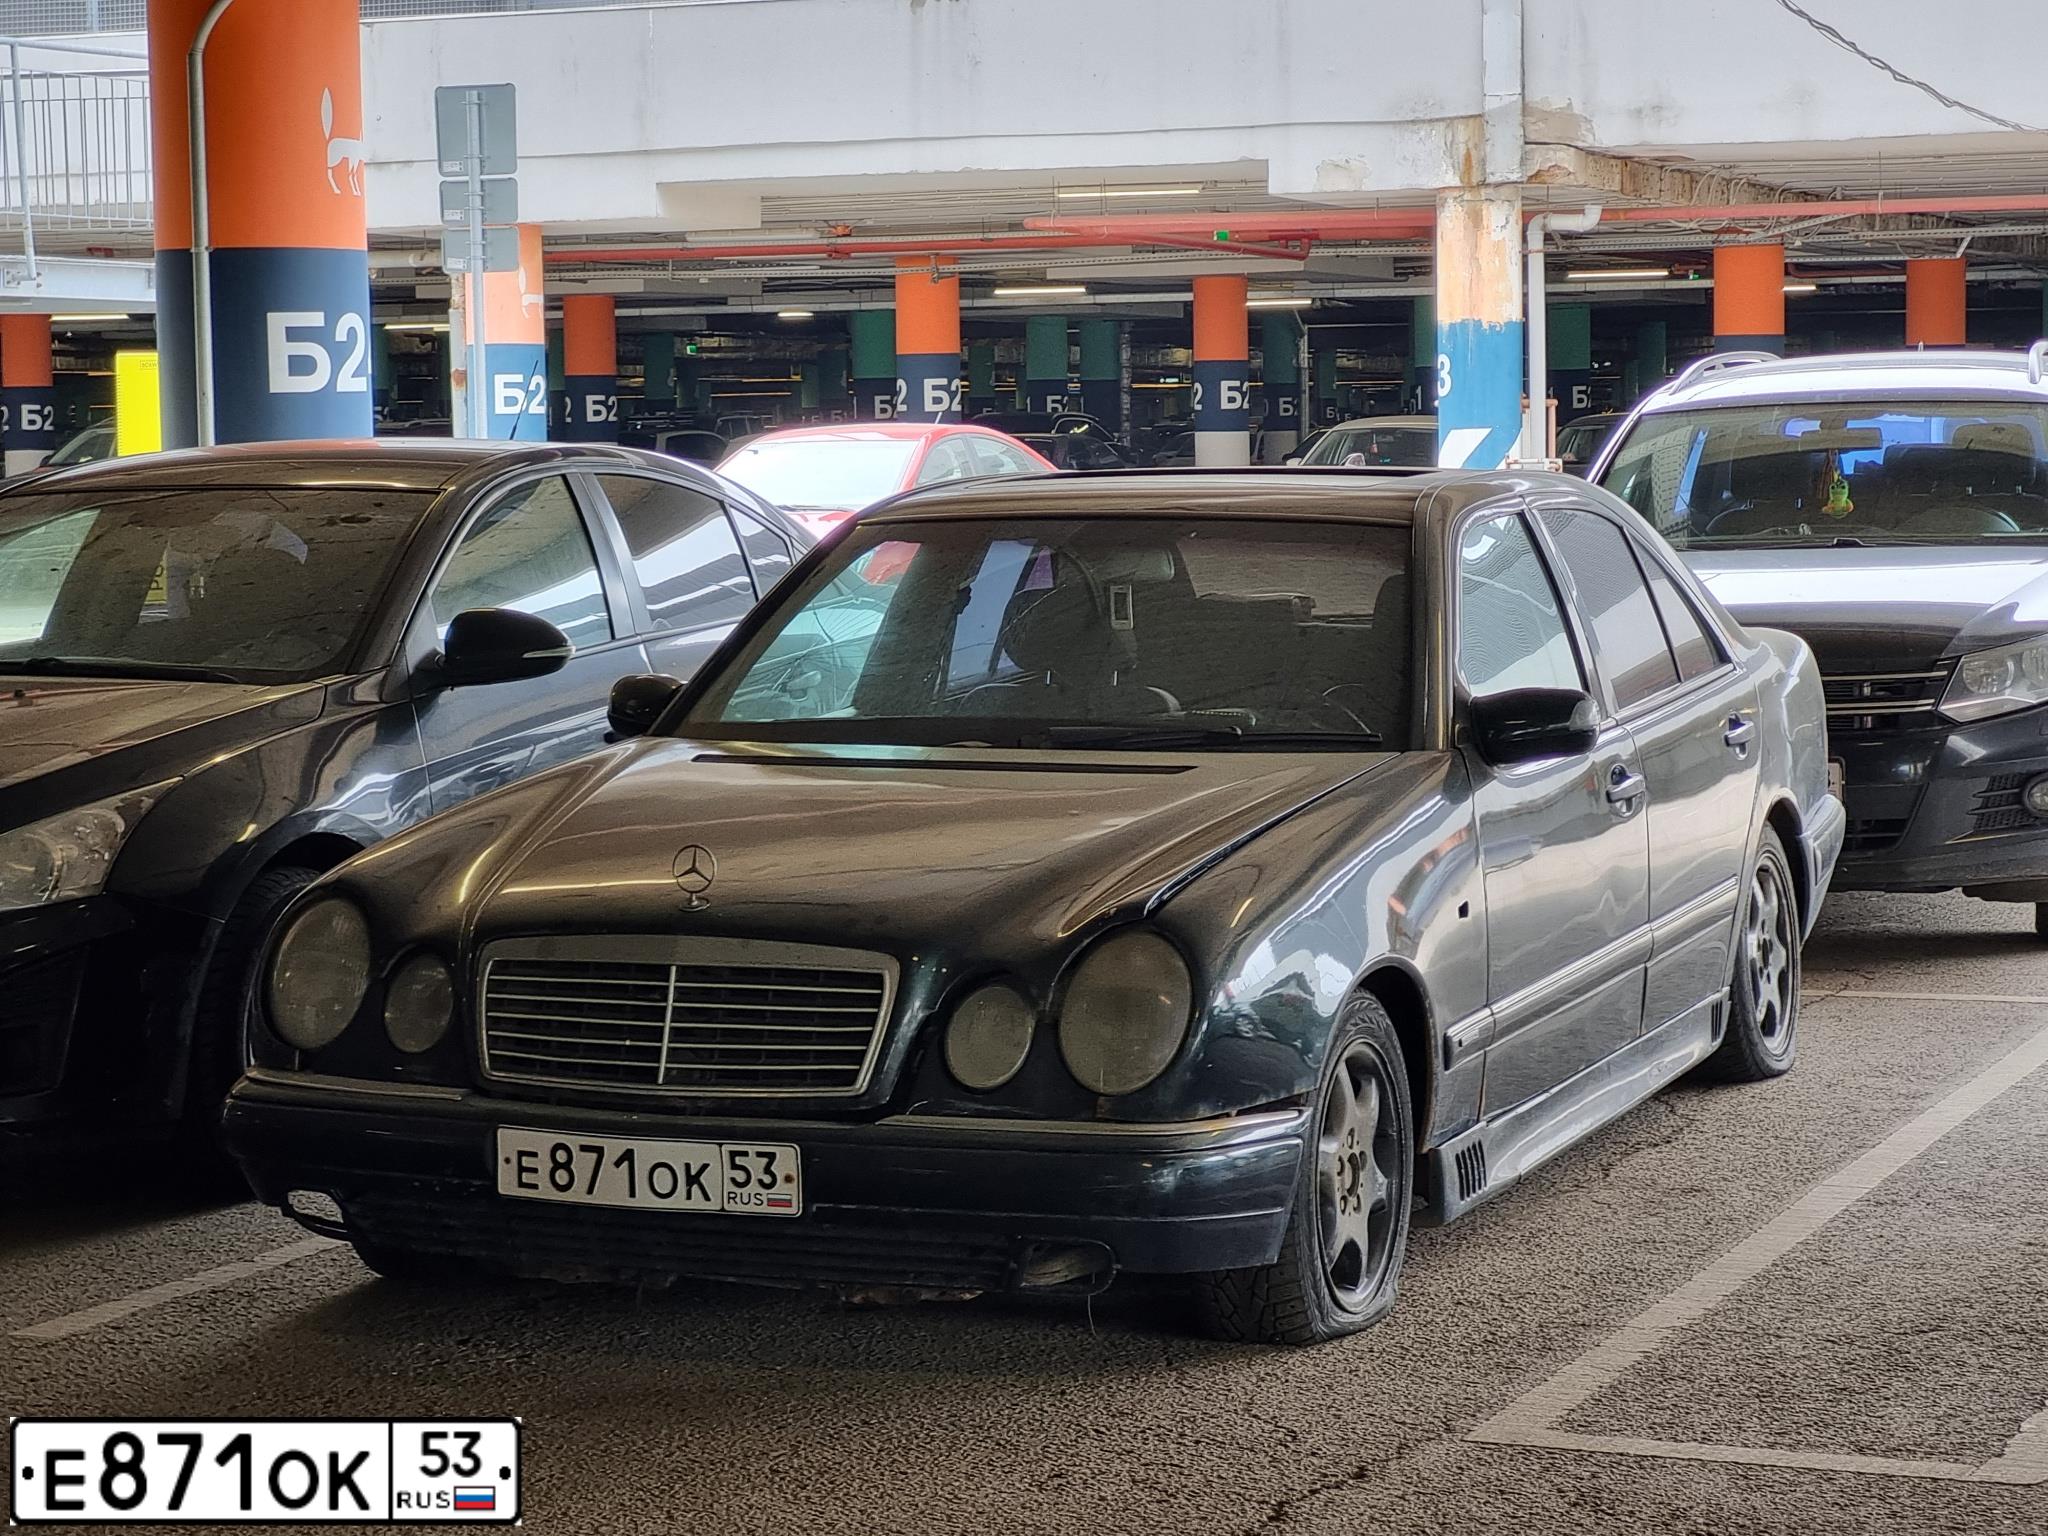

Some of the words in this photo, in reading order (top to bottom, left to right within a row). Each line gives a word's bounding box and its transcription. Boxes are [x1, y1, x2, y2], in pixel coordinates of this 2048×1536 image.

[266, 311, 368, 393] Б2
[494, 374, 547, 414] Б2
[585, 394, 618, 422] Б2
[923, 378, 962, 412] Б2
[20, 404, 55, 430] Б2
[516, 1142, 712, 1202] Е871ОК
[728, 1150, 778, 1190] 53
[727, 1192, 765, 1206] RUS
